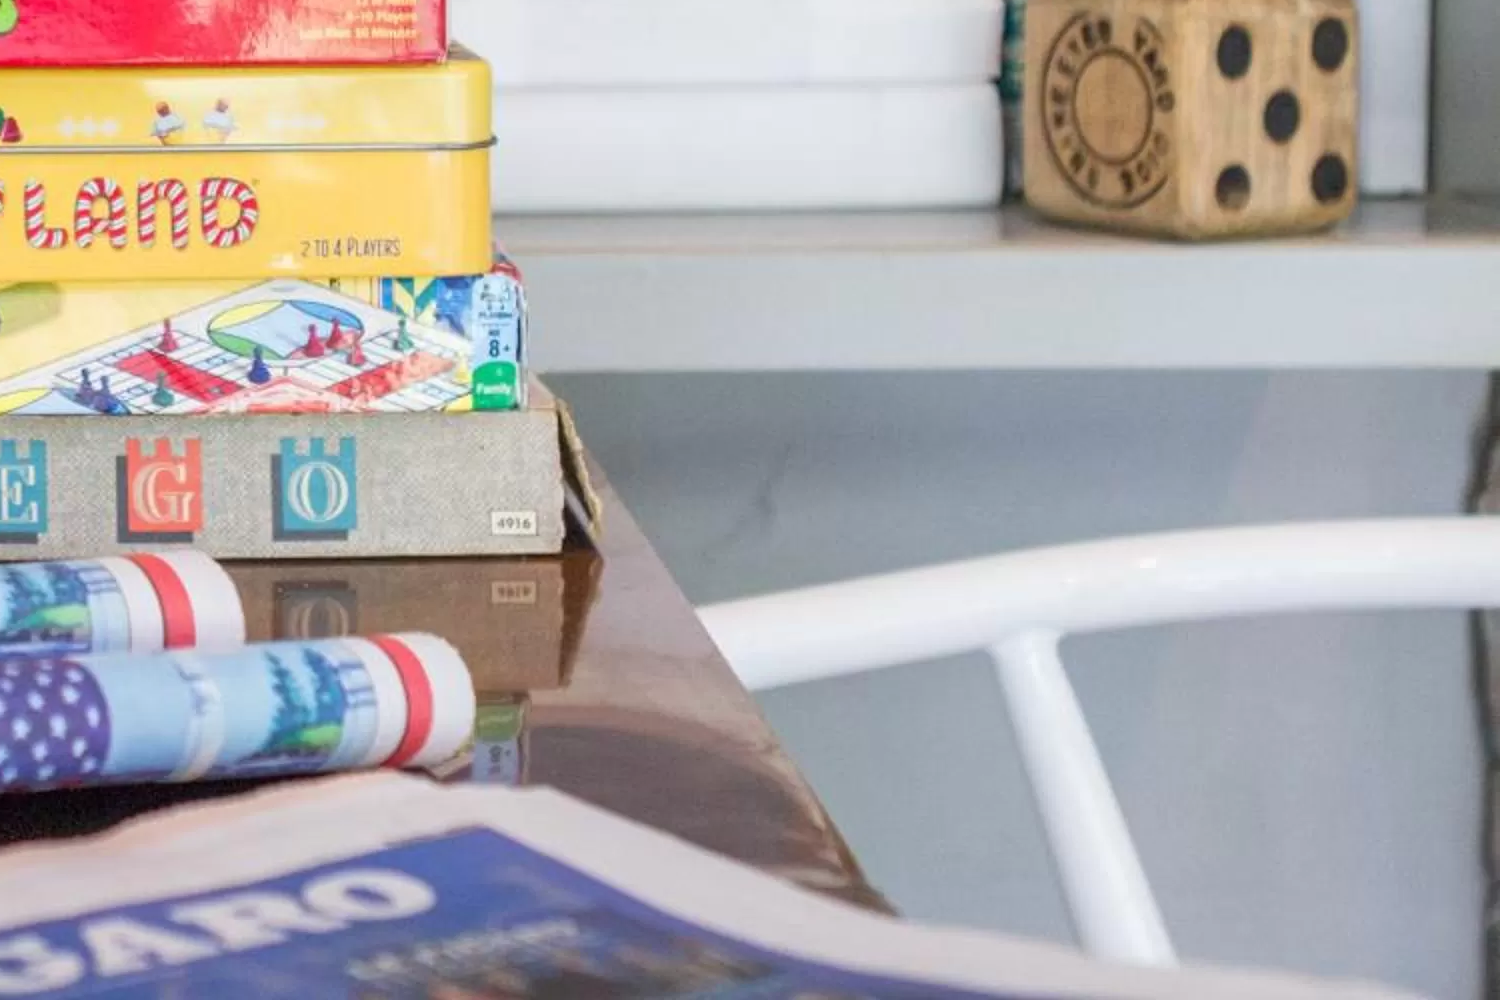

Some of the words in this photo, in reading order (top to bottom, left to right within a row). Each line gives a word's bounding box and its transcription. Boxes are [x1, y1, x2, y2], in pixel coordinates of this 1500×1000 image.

[23, 175, 261, 251] LAND
[300, 240, 312, 258] 2
[315, 239, 329, 258] TO
[333, 239, 343, 257] 4
[496, 516, 533, 531] 4916
